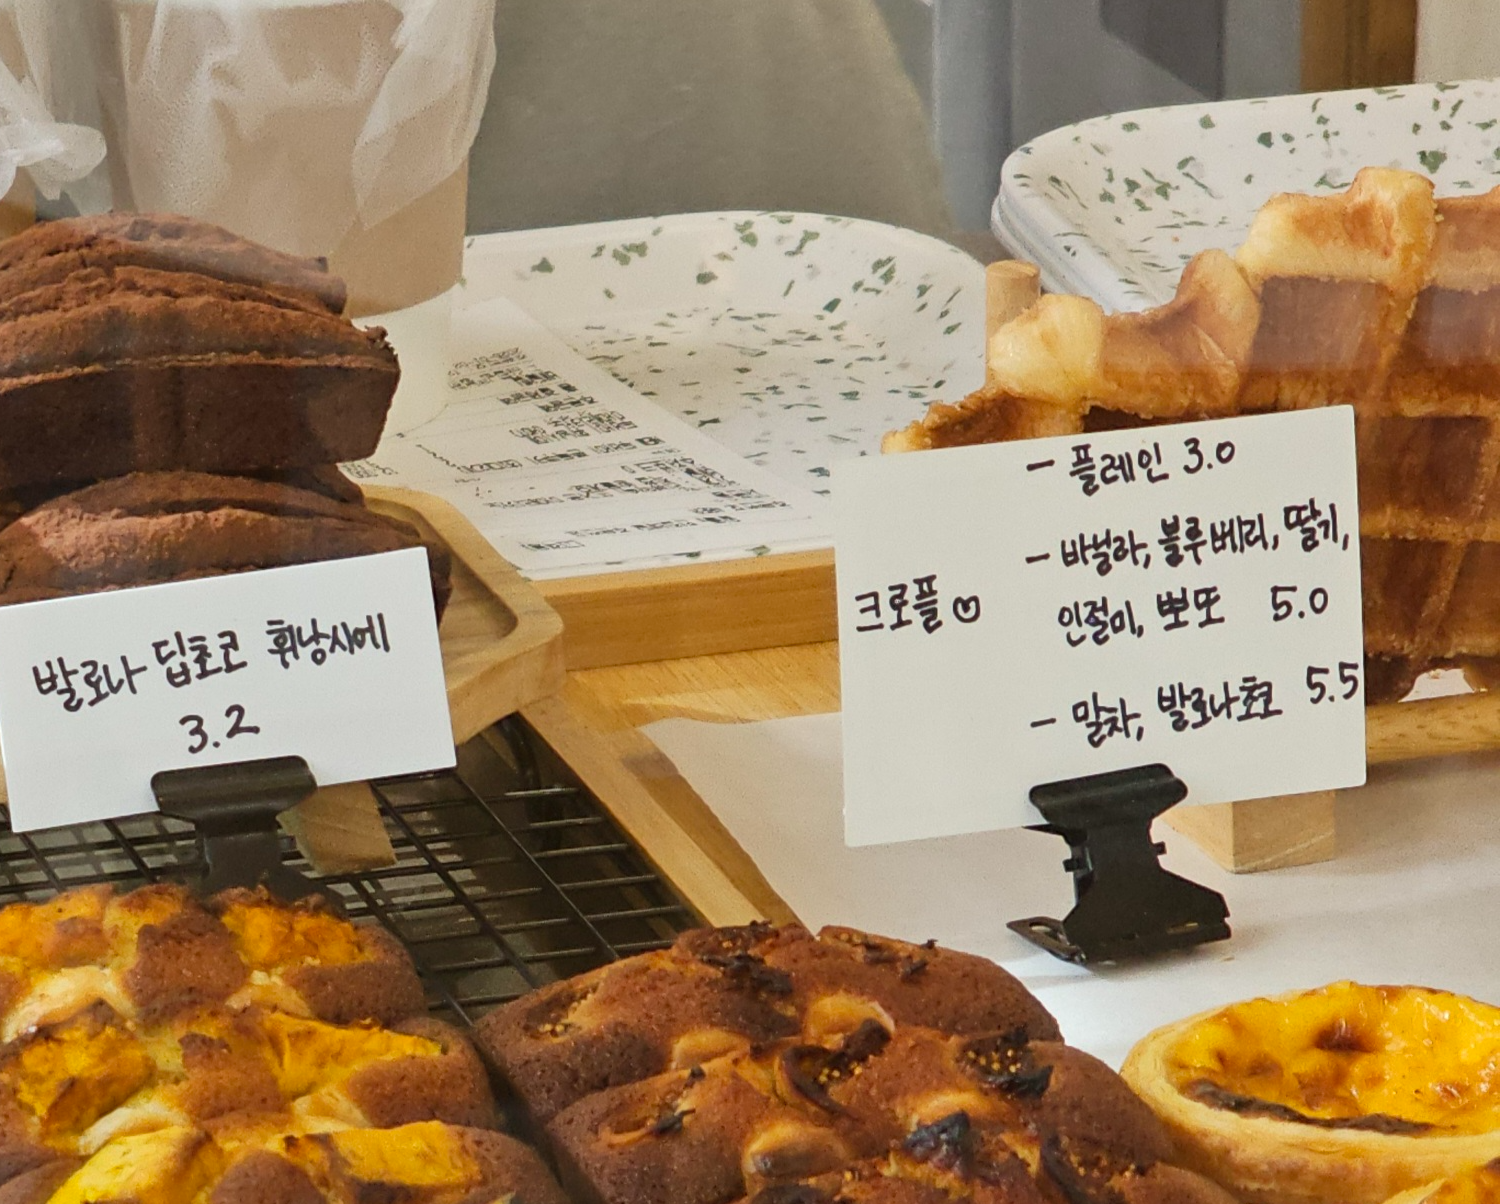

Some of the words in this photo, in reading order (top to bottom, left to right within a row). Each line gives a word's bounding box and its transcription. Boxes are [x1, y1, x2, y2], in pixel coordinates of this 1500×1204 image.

[1068, 441, 1170, 497] 플레인
[1182, 437, 1236, 475] 3.0
[1060, 528, 1152, 577] 바닐라,
[1157, 512, 1280, 568] 블루베리,
[1282, 497, 1350, 553] 딸기,
[854, 574, 944, 635] 크로플
[1057, 595, 1145, 648] 인절미,
[1156, 585, 1226, 632] 뽀또
[1270, 584, 1329, 623] 5.0
[31, 655, 148, 713] 발로나
[151, 629, 248, 688] 딥초코
[265, 612, 391, 670] 휘낭시에
[178, 703, 261, 755] 3.2
[1071, 691, 1145, 749] 말차,
[1305, 661, 1360, 705] 5.5
